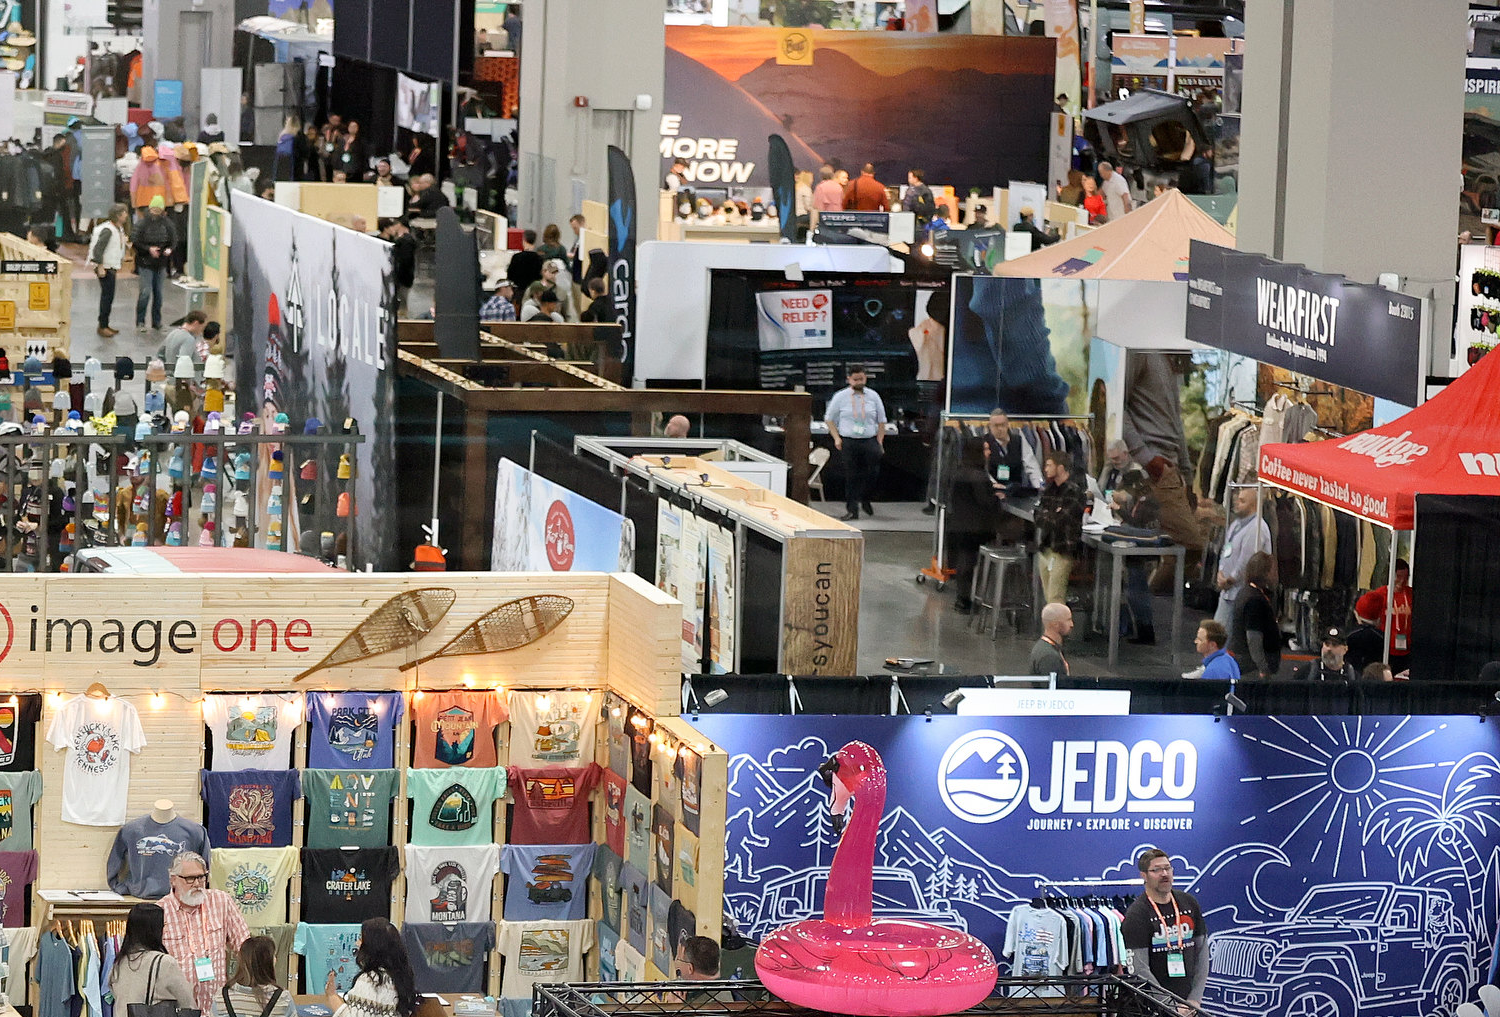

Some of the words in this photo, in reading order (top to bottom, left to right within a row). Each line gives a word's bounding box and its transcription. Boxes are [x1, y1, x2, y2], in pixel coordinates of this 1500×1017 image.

[781, 298, 809, 309] NEED
[1256, 277, 1340, 346] WEARFIRST
[316, 284, 386, 371] LOCALE
[1261, 454, 1292, 481] Coffee
[1292, 469, 1319, 492] never
[1319, 475, 1350, 503] tasted
[1351, 493, 1363, 509] so
[1363, 493, 1389, 518] good.
[30, 604, 197, 667] image
[212, 618, 313, 653] one
[332, 708, 355, 717] PARK
[1017, 700, 1035, 709] JEEP
[1037, 700, 1047, 709] BY
[1048, 700, 1075, 710] JEDCO
[75, 723, 107, 749] KENTUCKY
[106, 728, 119, 752] LAKE
[75, 754, 117, 773] TENNESSEE
[1028, 739, 1198, 814] JEDCO
[1027, 819, 1073, 830] JOURNEY
[1086, 819, 1130, 830] EXPLORE
[1143, 818, 1193, 830] DISCOVER
[326, 881, 353, 891] CRATER
[354, 880, 371, 890] LAKE
[431, 911, 465, 921] MONTANA
